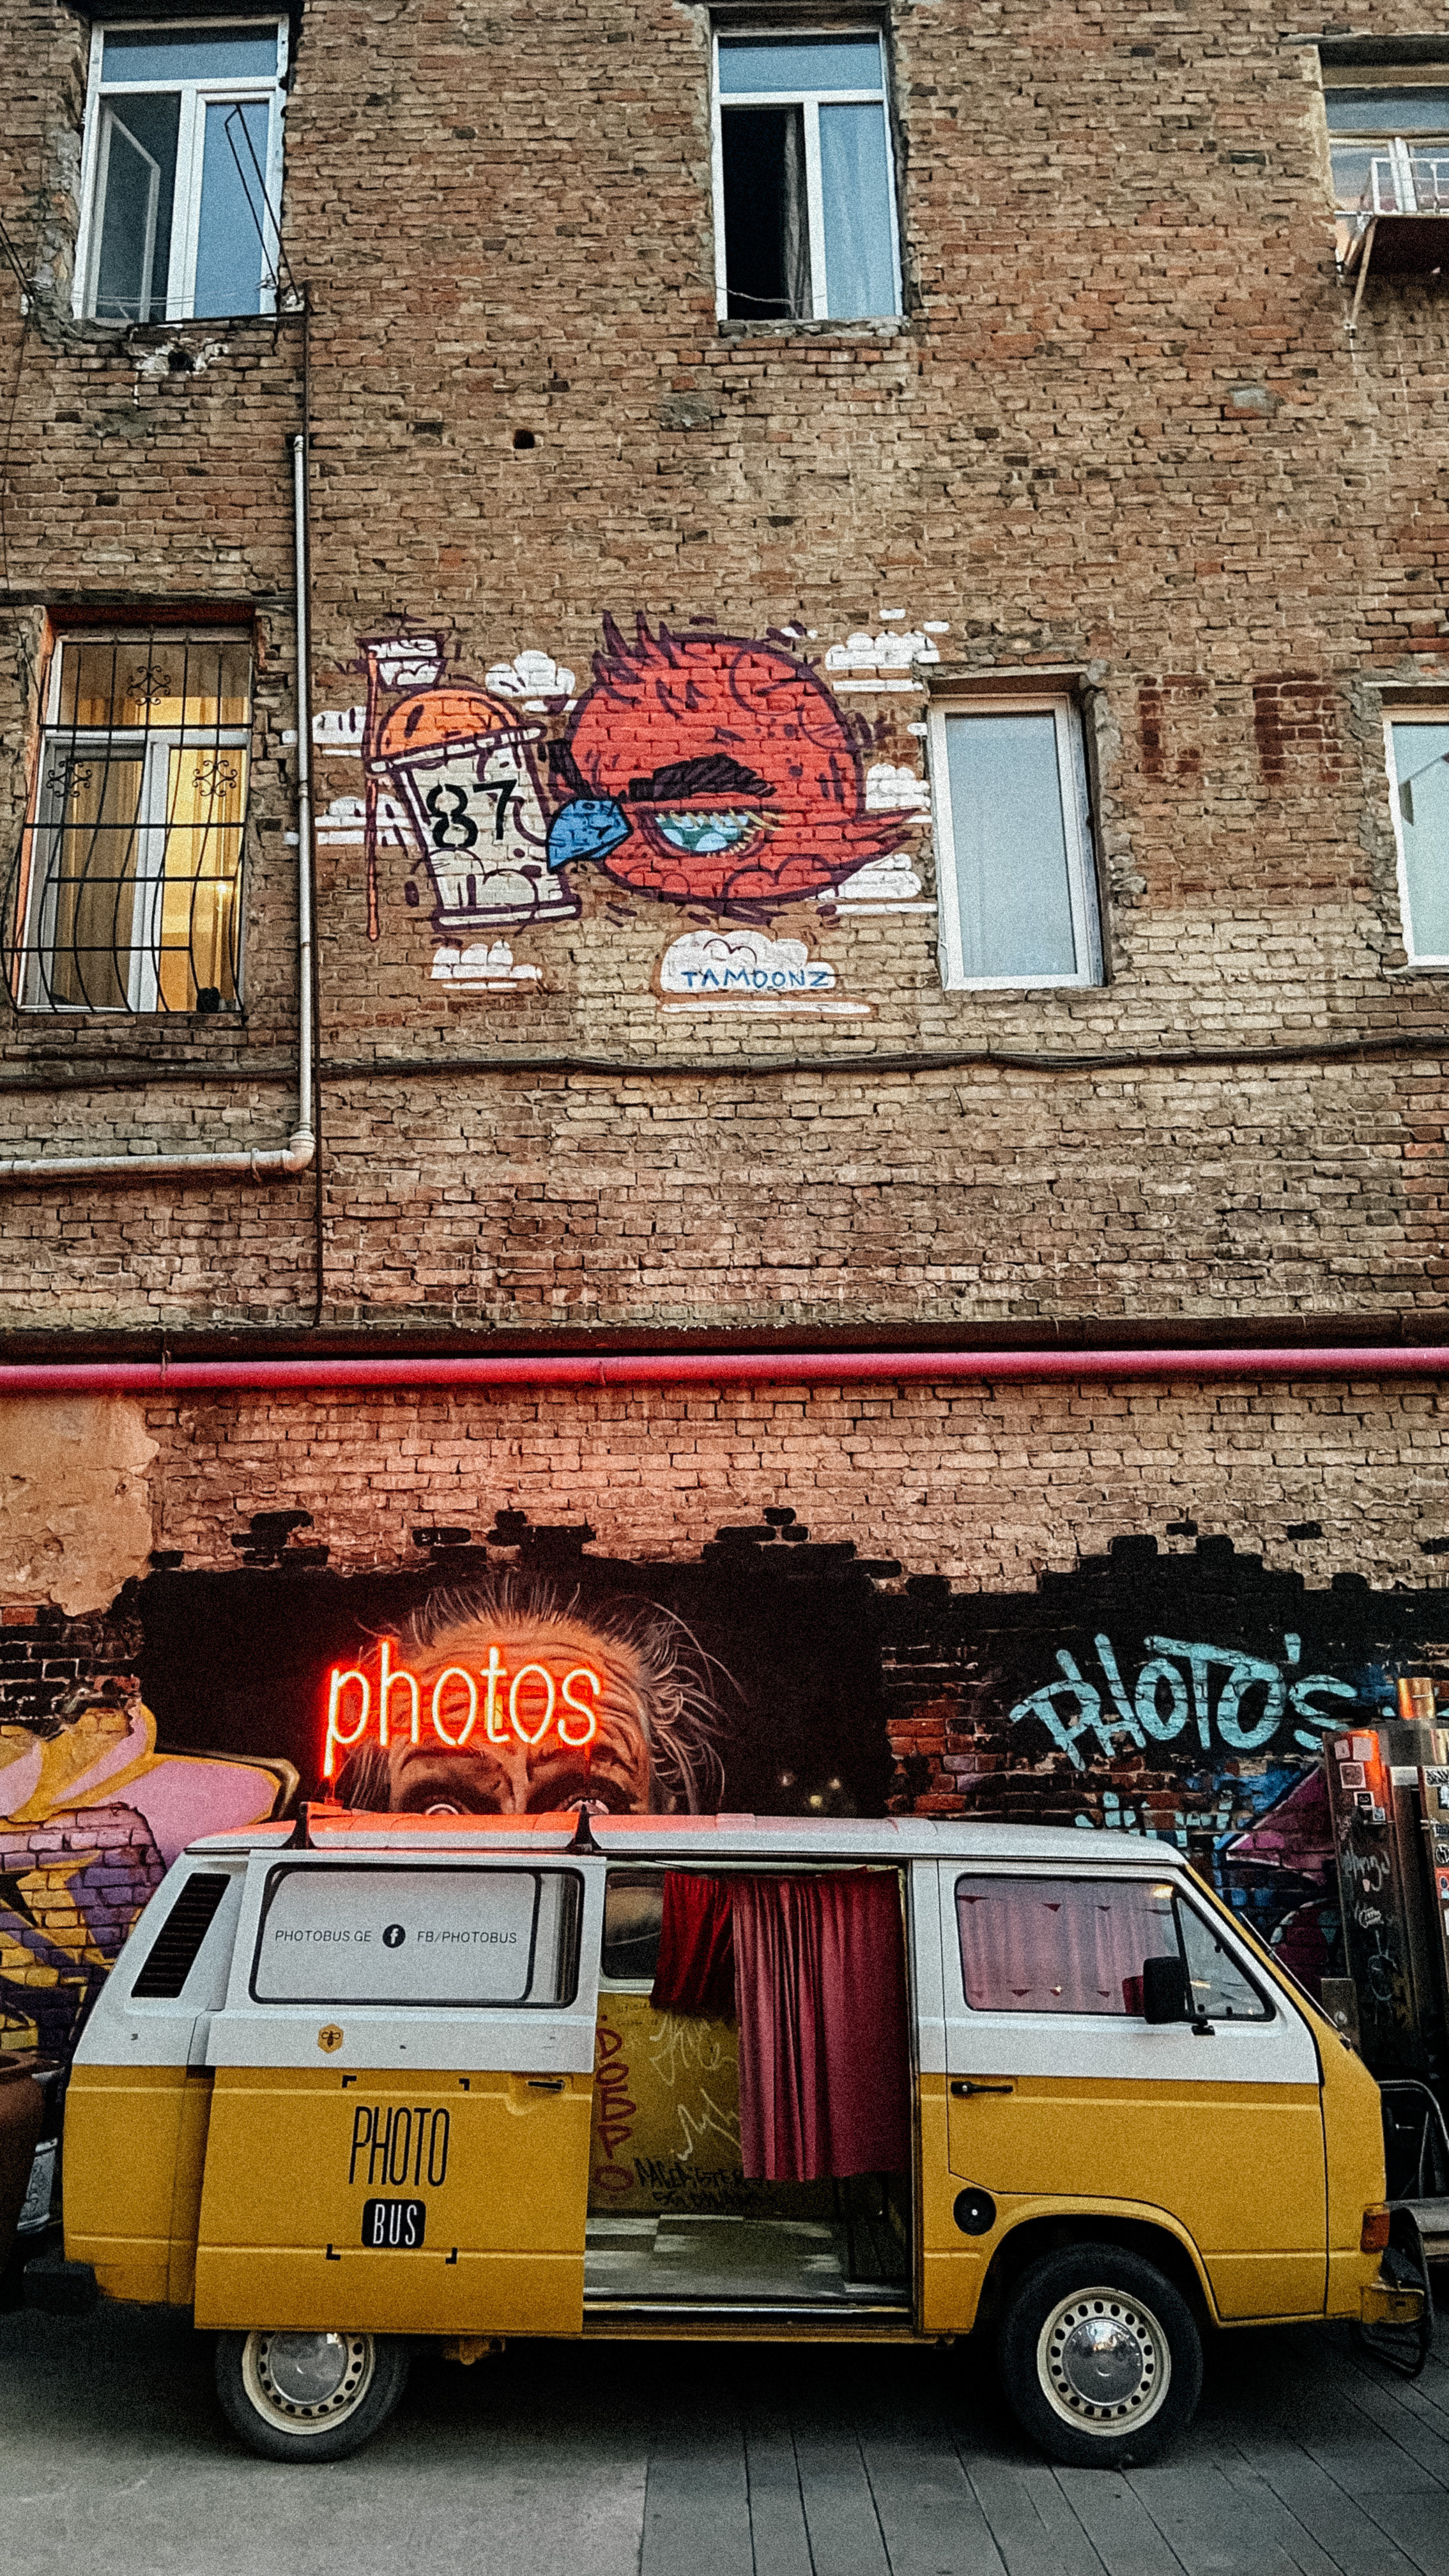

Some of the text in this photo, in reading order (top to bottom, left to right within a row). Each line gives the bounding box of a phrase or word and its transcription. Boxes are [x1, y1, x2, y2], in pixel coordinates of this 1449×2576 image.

[426, 779, 517, 848] 87
[681, 968, 829, 988] TAMOONZ
[323, 1640, 601, 1777] photos
[275, 1929, 372, 1942] PHOTOBUS.GE
[417, 1930, 518, 1944] FB/PHOTOBUS
[348, 2106, 450, 2186] PHOTO
[372, 2204, 417, 2246] BUS
